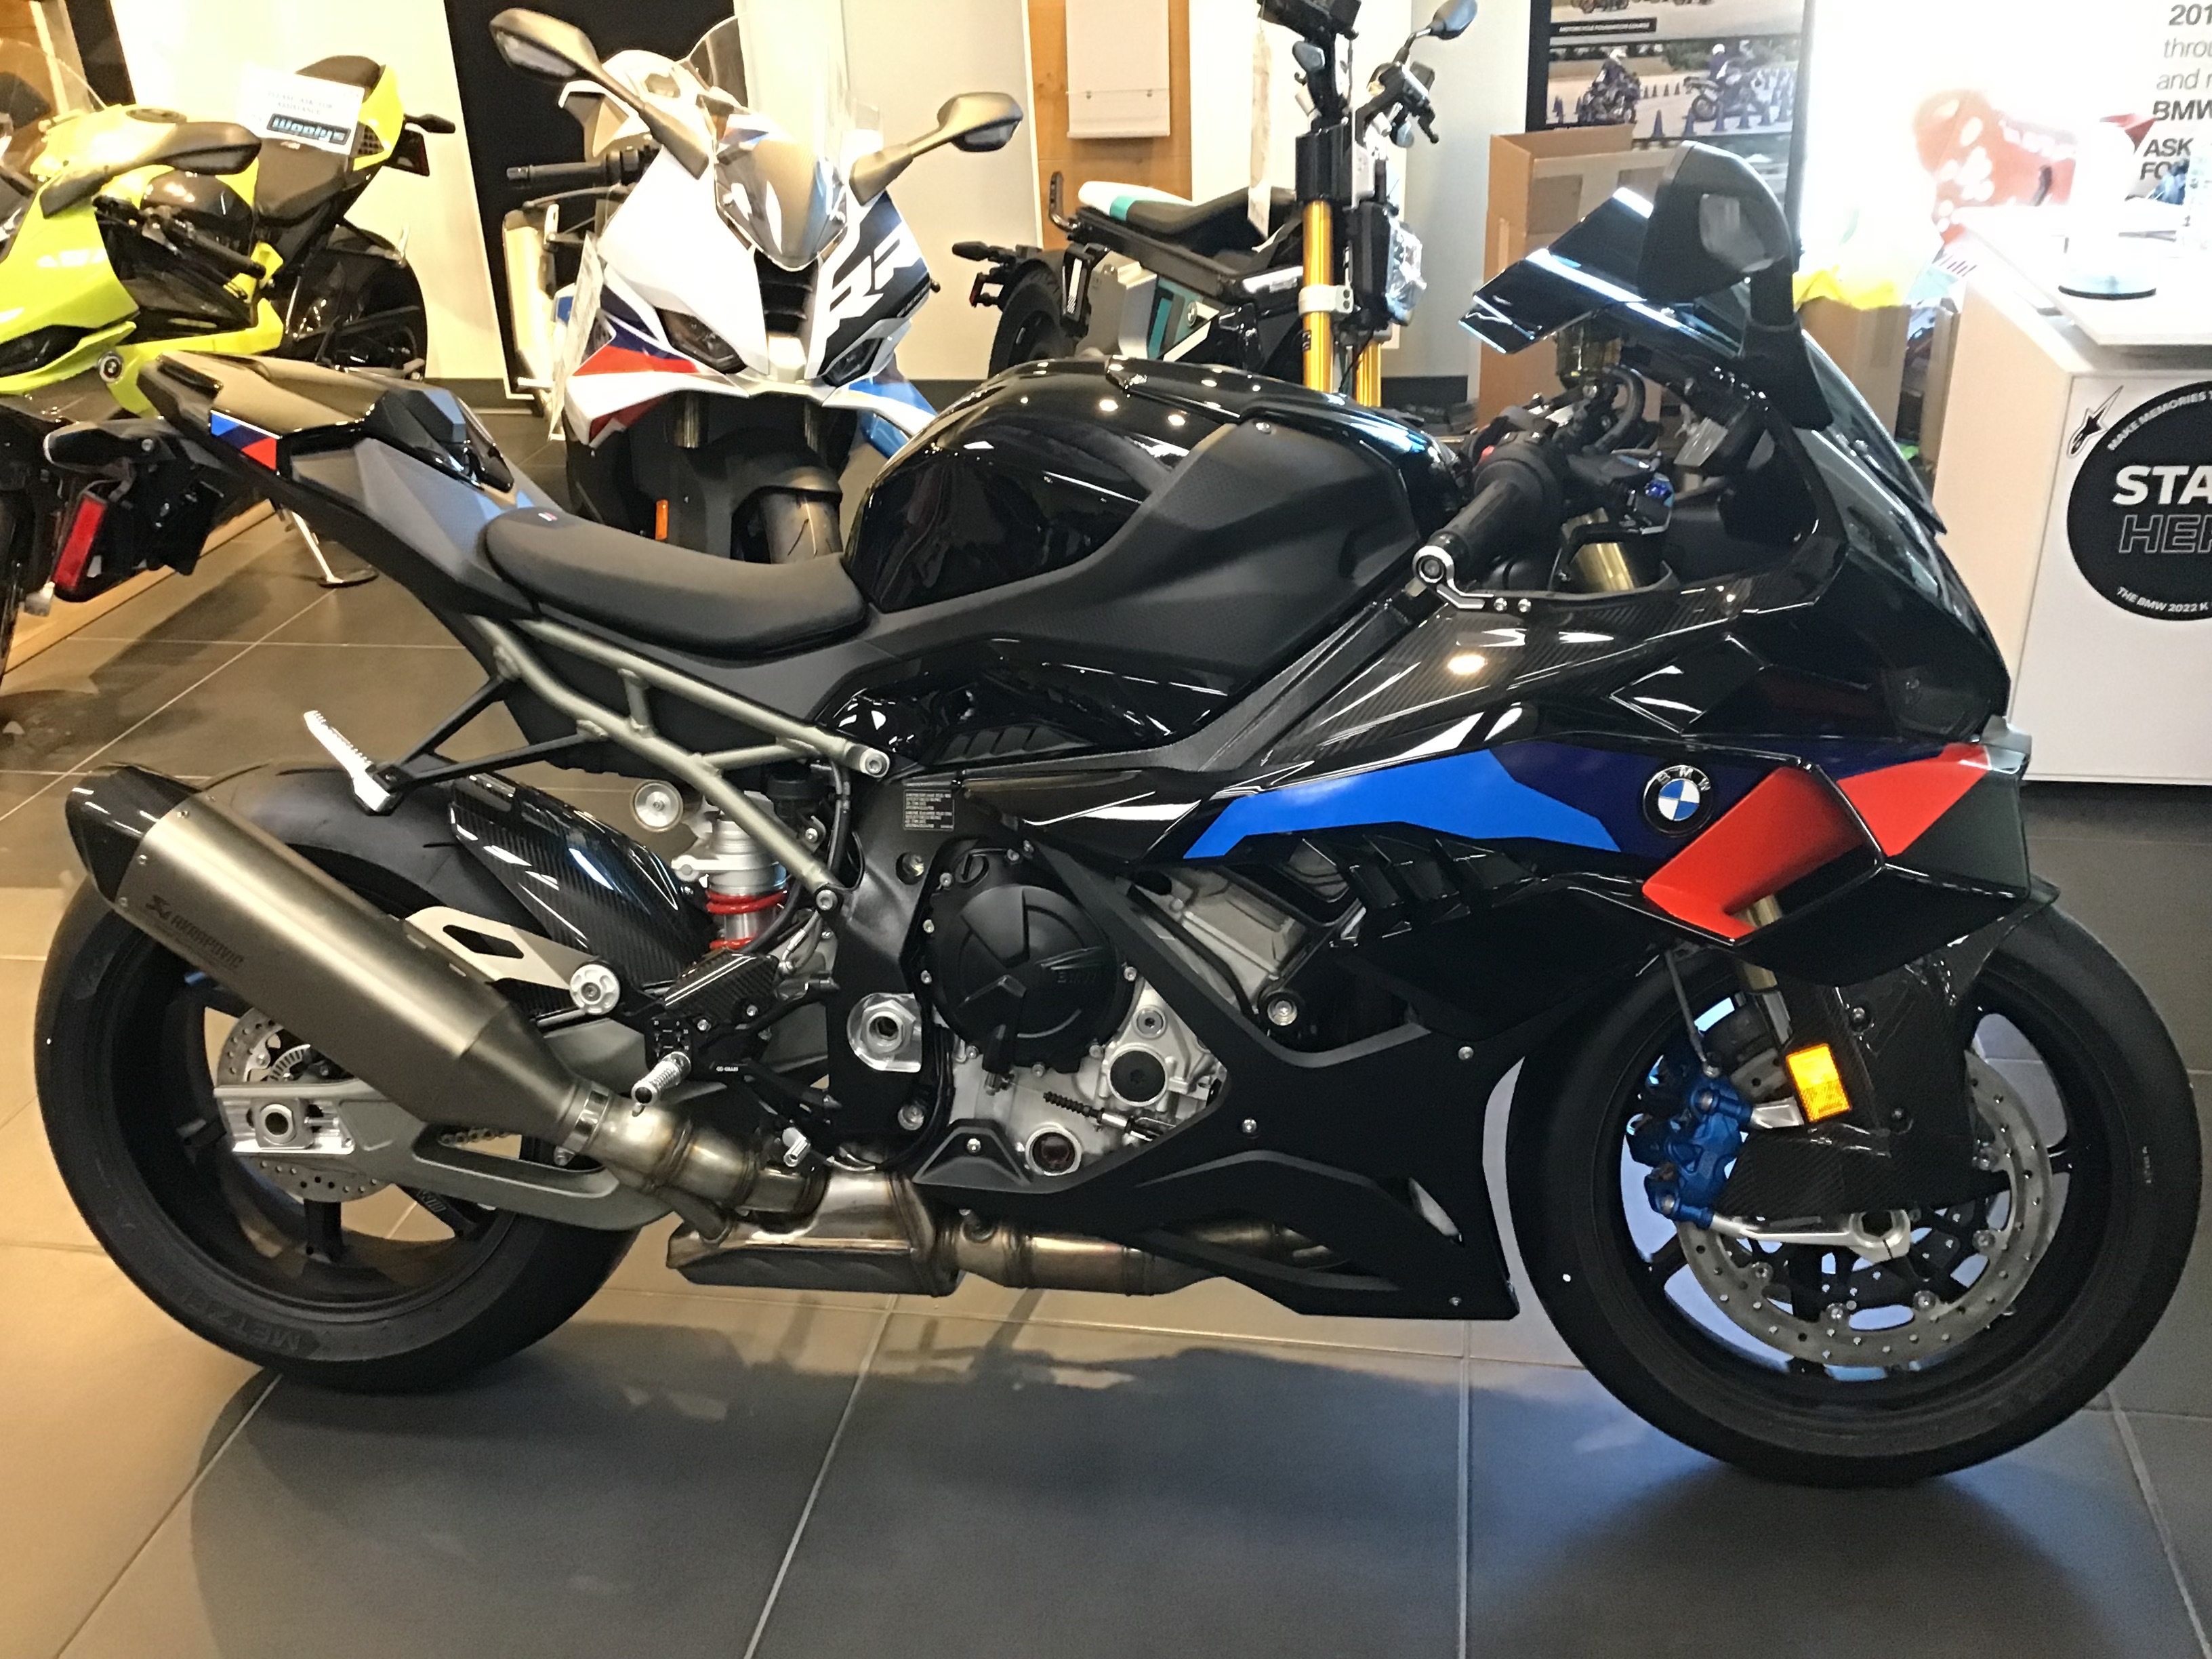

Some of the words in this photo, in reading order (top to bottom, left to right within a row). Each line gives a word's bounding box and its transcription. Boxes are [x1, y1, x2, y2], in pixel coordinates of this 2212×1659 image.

[2156, 68, 2200, 91] and
[2153, 99, 2212, 121] BMW
[2143, 138, 2194, 157] ASK
[2107, 420, 2141, 451] MAKE
[2138, 391, 2207, 425] MEMORIES
[2112, 465, 2212, 506] STA
[2116, 586, 2139, 603] THE
[2136, 596, 2168, 611] BMW
[2168, 602, 2198, 613] 2022
